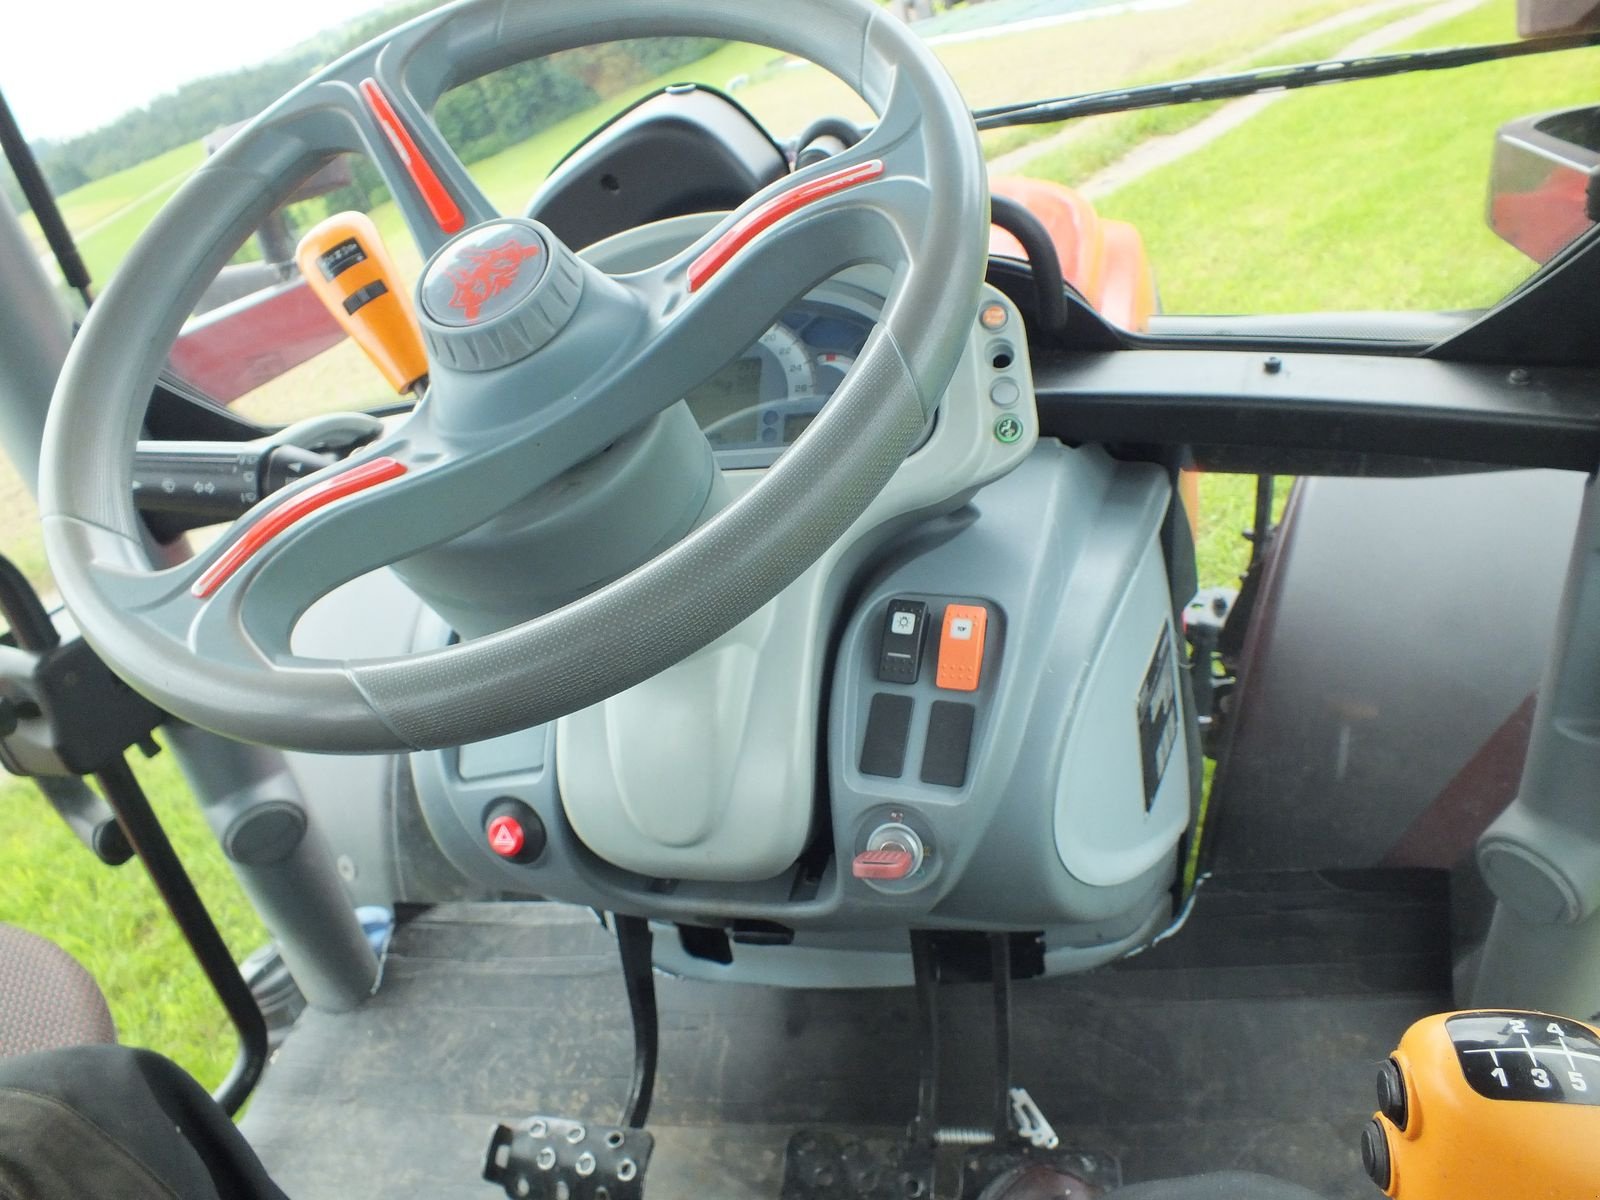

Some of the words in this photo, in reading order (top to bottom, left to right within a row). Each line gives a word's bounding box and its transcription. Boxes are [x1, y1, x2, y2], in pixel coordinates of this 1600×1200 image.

[1509, 1019, 1530, 1034] 2
[1546, 1022, 1565, 1037] 4
[1490, 1067, 1509, 1088] 1
[1530, 1068, 1551, 1089] 3
[1567, 1071, 1588, 1092] 5
